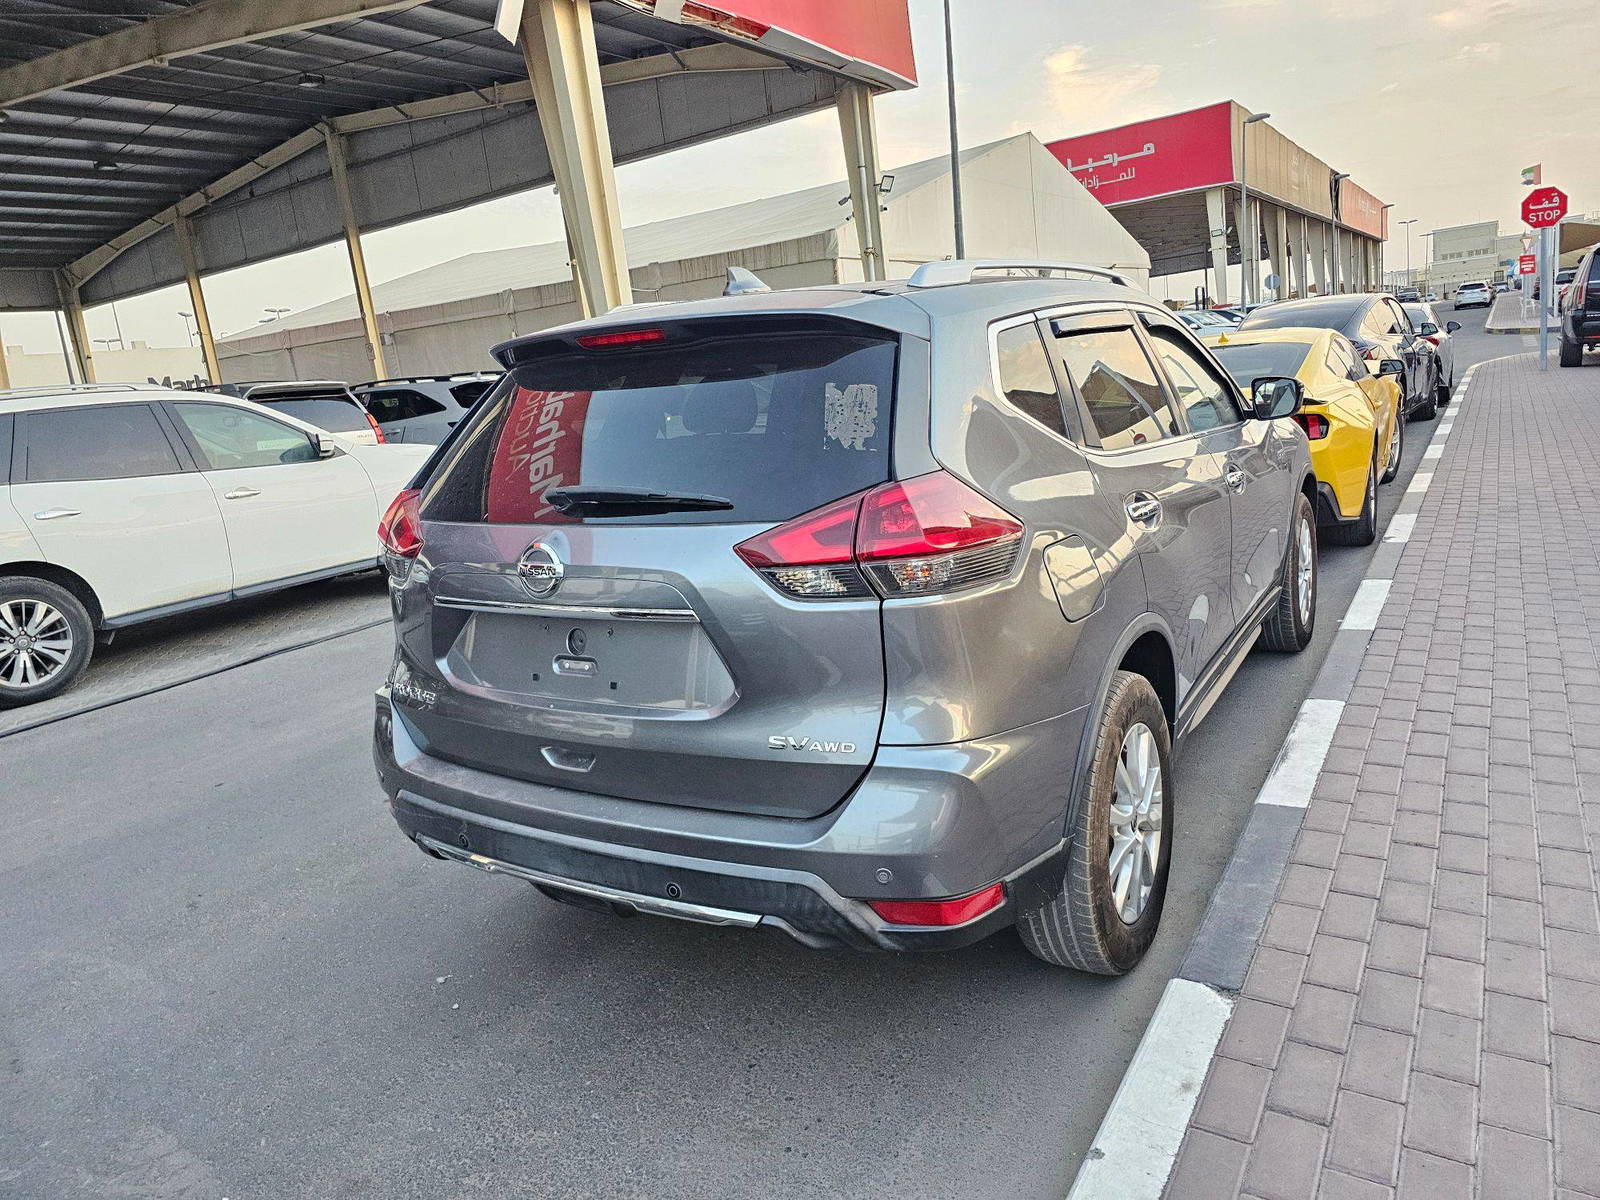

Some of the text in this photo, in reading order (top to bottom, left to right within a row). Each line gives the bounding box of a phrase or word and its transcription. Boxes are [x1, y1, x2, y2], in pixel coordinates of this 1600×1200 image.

[1067, 143, 1155, 172] مرحبا
[1529, 192, 1560, 209] قف
[1528, 209, 1560, 222] STOP
[519, 564, 557, 577] NISSAN
[768, 735, 857, 753] SV AWD
